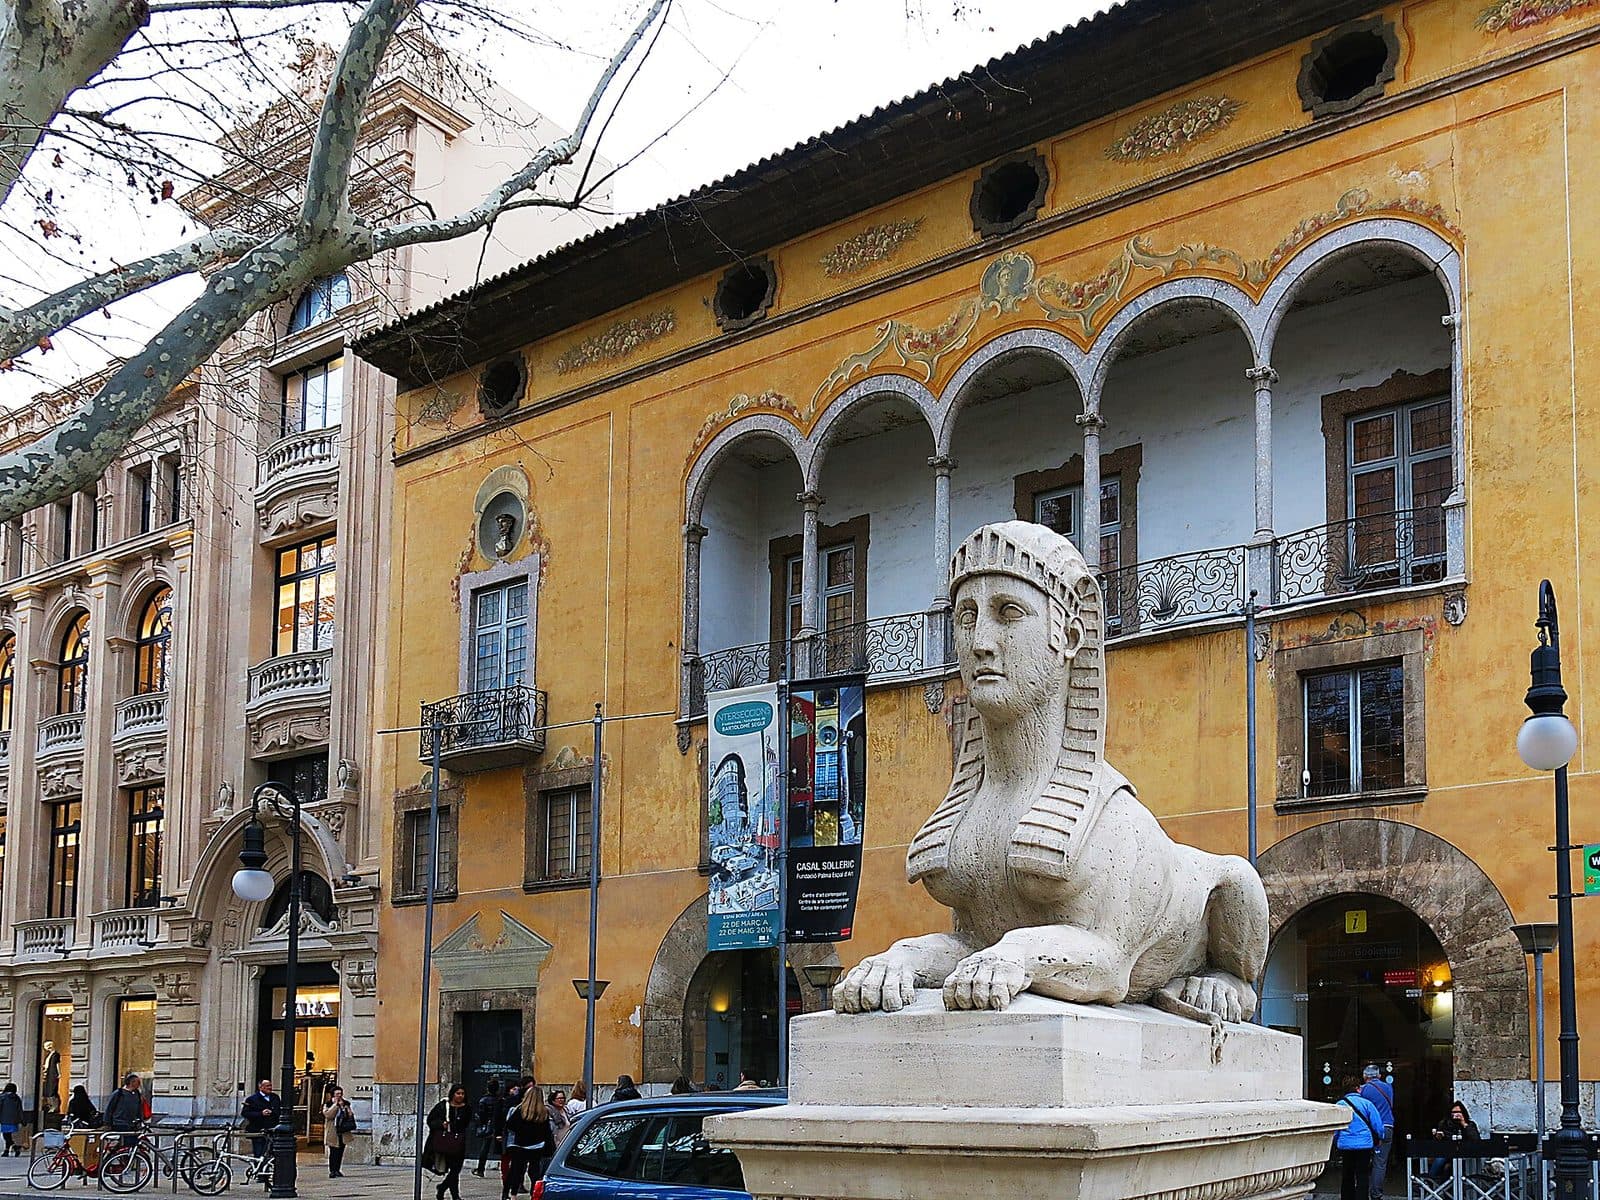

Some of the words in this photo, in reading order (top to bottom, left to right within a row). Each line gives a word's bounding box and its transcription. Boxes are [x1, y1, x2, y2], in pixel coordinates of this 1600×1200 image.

[796, 862, 820, 871] CASAL
[822, 860, 855, 870] SOLLERIC
[737, 927, 755, 935] MAIG
